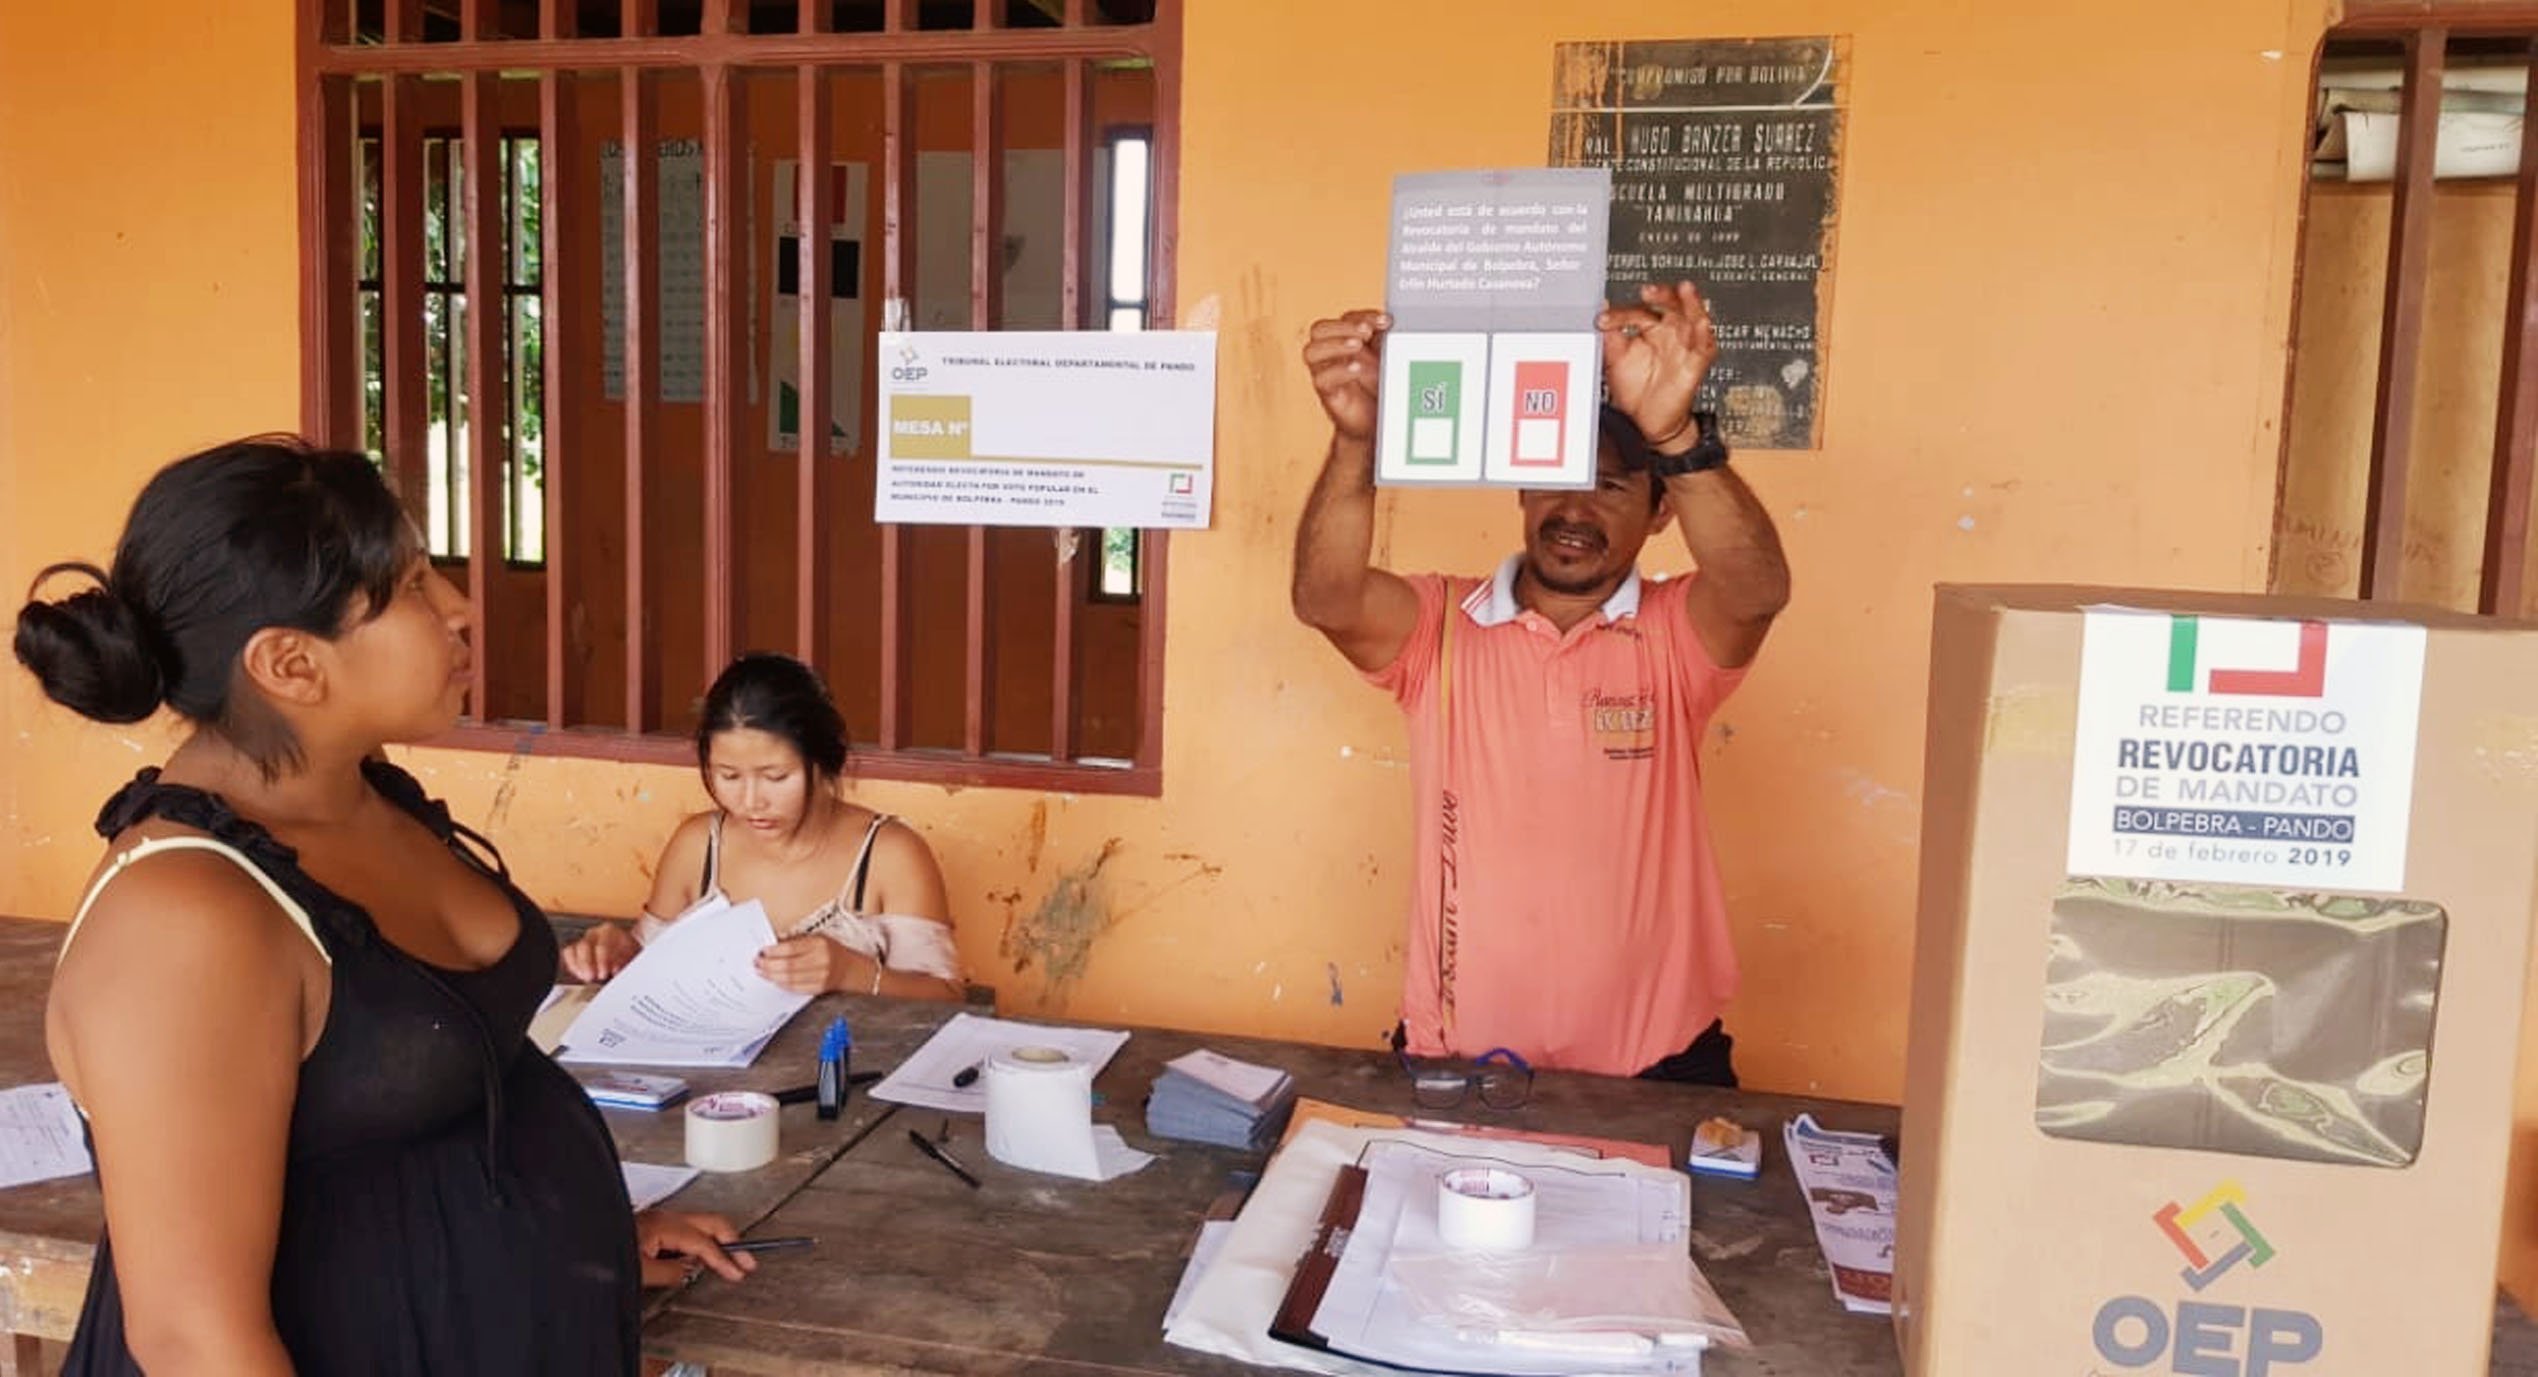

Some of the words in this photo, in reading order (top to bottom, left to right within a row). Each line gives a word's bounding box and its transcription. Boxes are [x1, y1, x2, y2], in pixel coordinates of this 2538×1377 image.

[1477, 204, 1495, 217] de
[1481, 223, 1497, 235] de
[892, 366, 929, 382] OEP
[1524, 389, 1557, 415] NO
[894, 418, 945, 436] MESA
[2139, 704, 2346, 735] REFERENDO
[2118, 738, 2360, 778] REVOCATORIA
[2116, 775, 2160, 800] DE
[2178, 778, 2358, 808] MANDATO
[2116, 809, 2241, 834] BOLPEBRA
[2263, 815, 2352, 840] PANDO
[2113, 838, 2137, 856] 17
[2147, 841, 2177, 861] de
[2188, 840, 2278, 865] febrero
[2288, 847, 2352, 867] 2019
[2092, 1295, 2323, 1377] OEP
